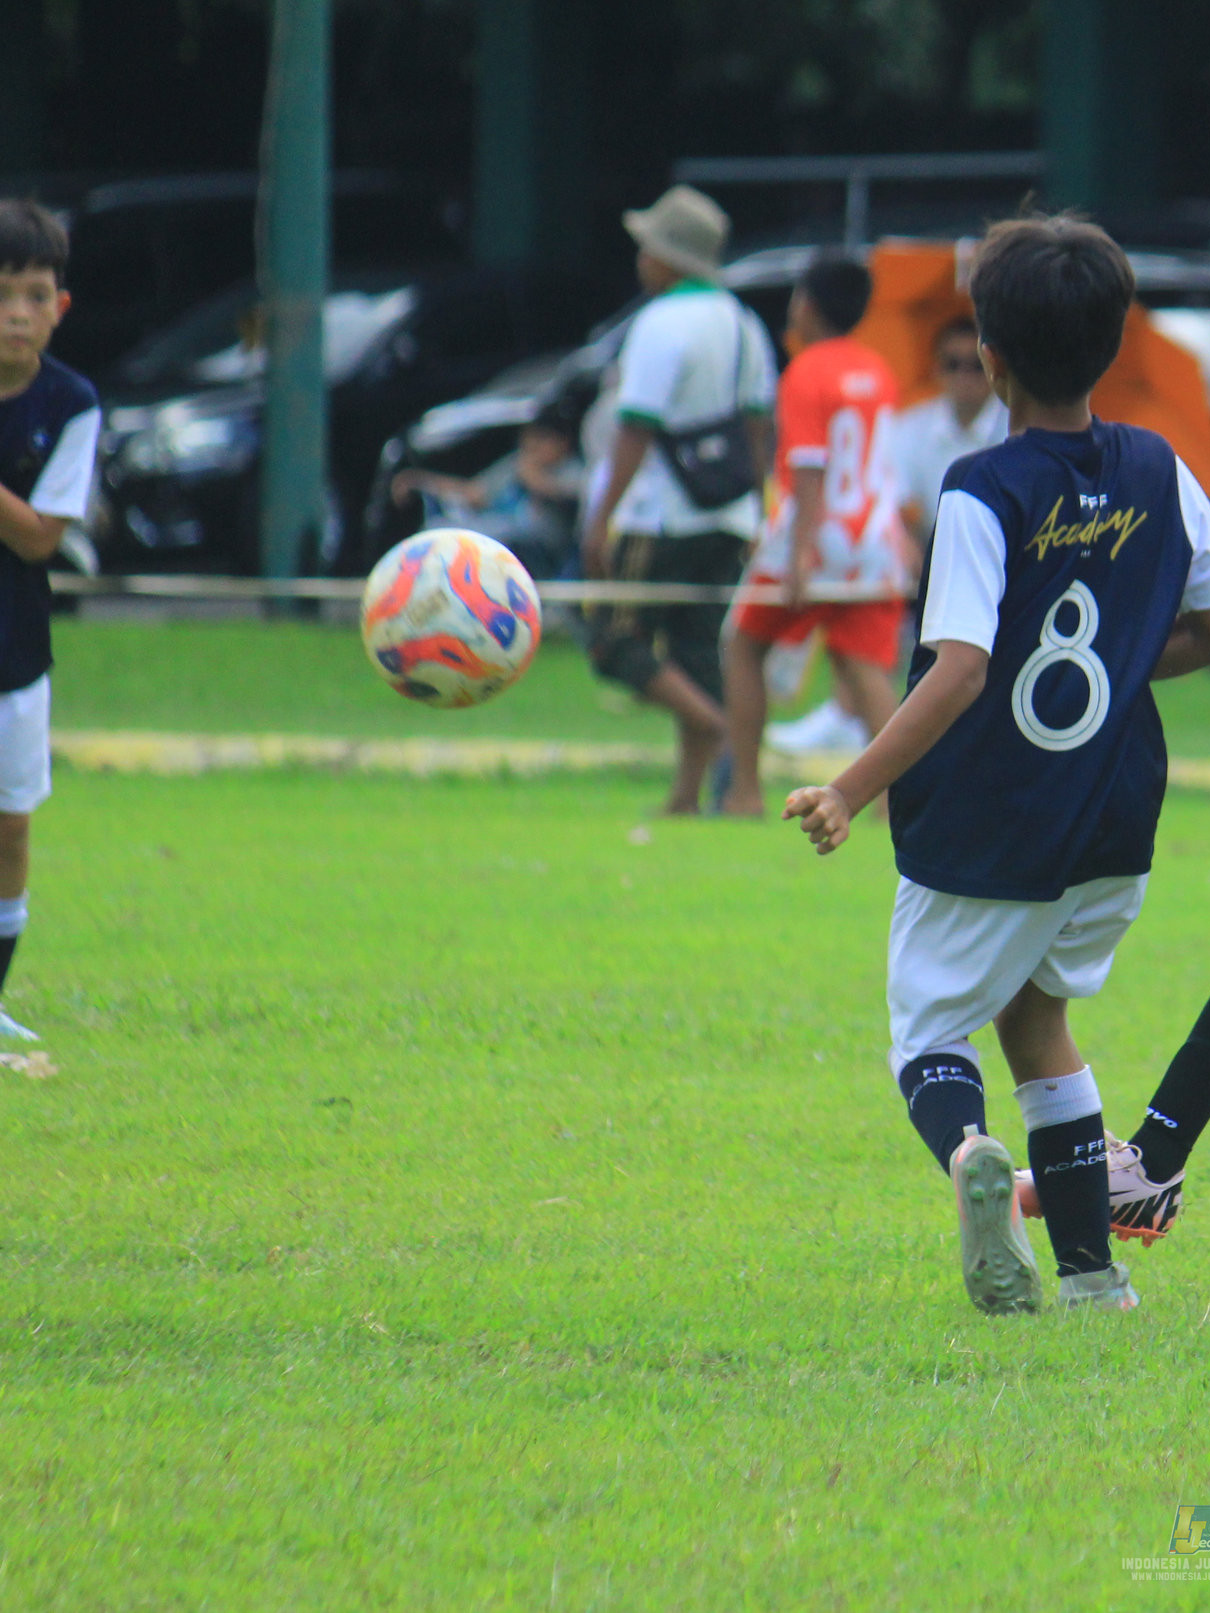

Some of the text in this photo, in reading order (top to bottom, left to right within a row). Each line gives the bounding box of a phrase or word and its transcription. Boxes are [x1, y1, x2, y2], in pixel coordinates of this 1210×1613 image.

[1079, 493, 1108, 510] FFF
[1011, 579, 1111, 751] 8
[1074, 1138, 1105, 1157] FFF
